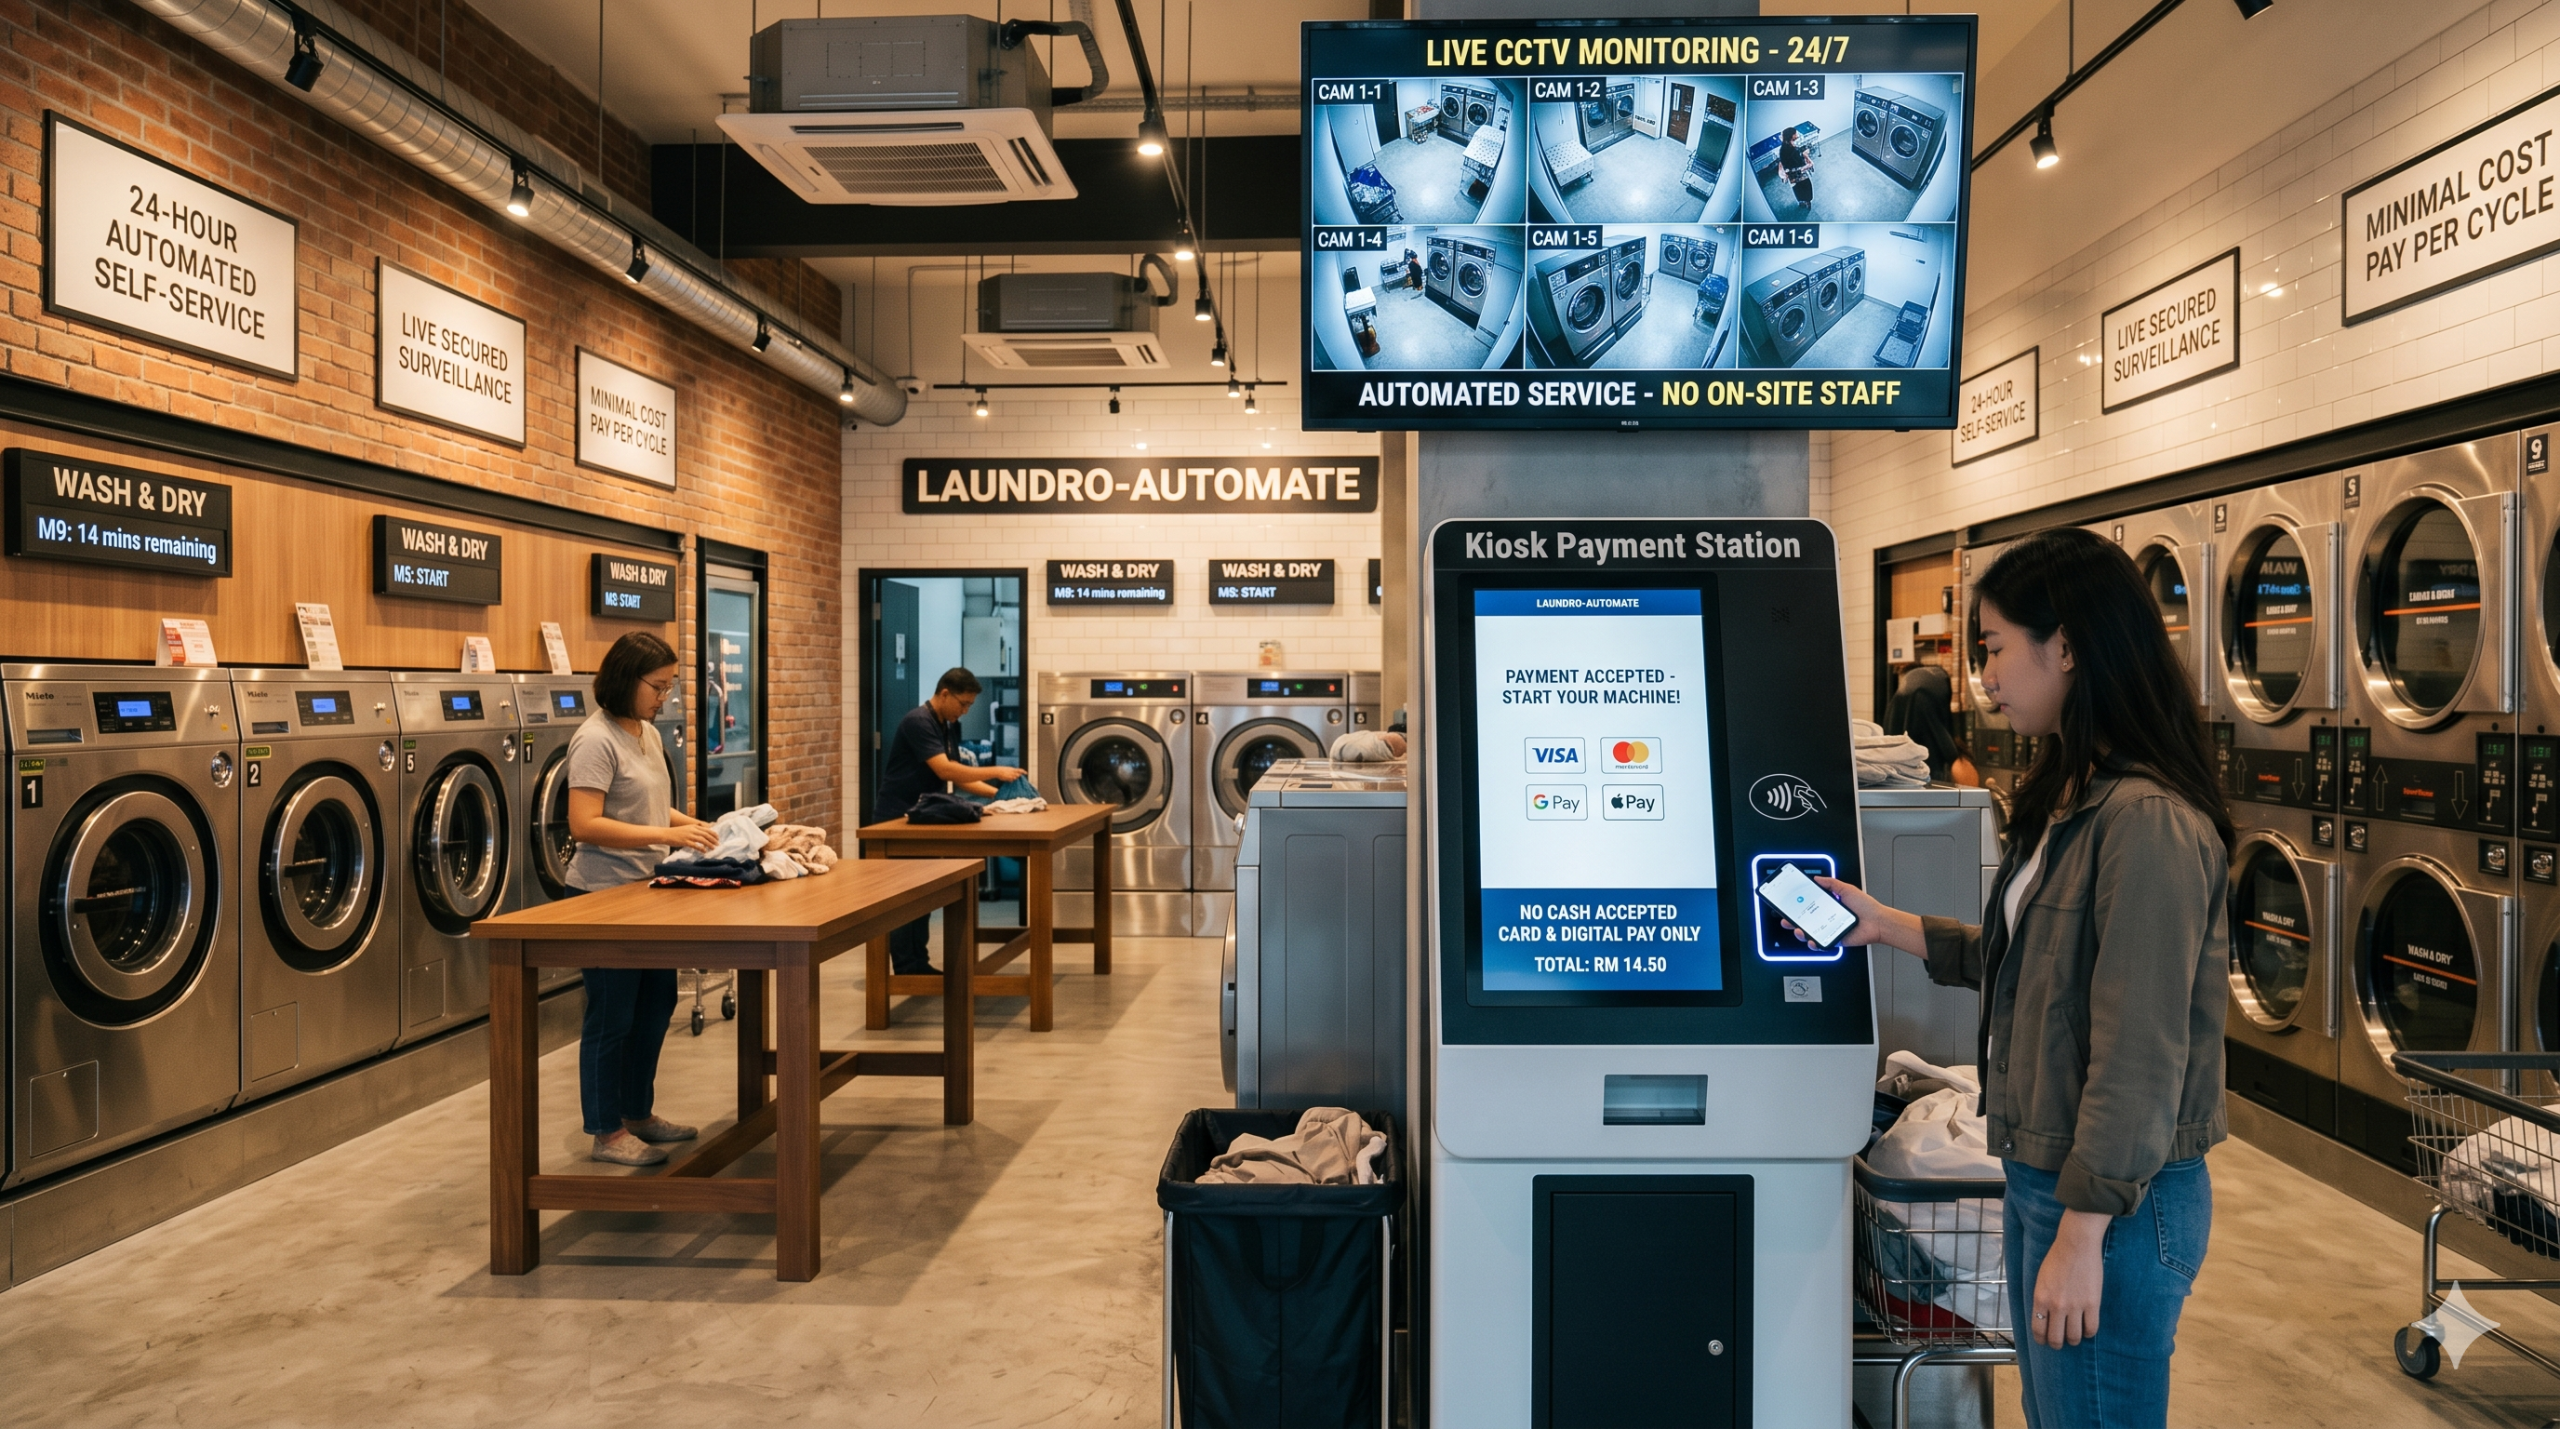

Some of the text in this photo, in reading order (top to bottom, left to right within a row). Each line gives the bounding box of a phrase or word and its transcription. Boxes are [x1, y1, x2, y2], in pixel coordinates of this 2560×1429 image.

[1427, 36, 1850, 66] LIVE CCTV MONITORING - 24/7
[1318, 84, 1382, 100] CAM 1-1
[1535, 82, 1600, 98] CAM 1-2
[1754, 80, 1818, 96] CAM 1-3
[2367, 129, 2552, 242] MINIMAL COST
[130, 185, 237, 253] 24-HOUR
[2367, 175, 2554, 282] PAY PER CYCLE
[1318, 232, 1383, 247] CAM 1-4
[1532, 230, 1597, 246] CAM 1-5
[1748, 229, 1813, 245] CAM 1-6
[106, 219, 257, 297] AUTOMATED
[94, 257, 265, 340] SELF-SERVICE
[2118, 288, 2216, 351] LIVE SECURED
[402, 312, 508, 372] LIVE SECURED
[2114, 318, 2221, 382] SURVEILLANCE
[399, 346, 512, 404] SURVEILLANCE
[1359, 382, 1520, 407] AUTOMATED
[1527, 381, 1636, 407] SERVICE
[1662, 381, 1699, 406] NO
[1707, 380, 1813, 406] ON-SITE
[1819, 380, 1901, 405] STAFF
[1971, 380, 2013, 414] 24-HOUR
[591, 386, 667, 430] MINIMAL COST
[1961, 400, 2026, 443] SELF-SERVICE
[591, 414, 667, 456] PAY PER CYCLE
[2531, 438, 2543, 460] 9
[53, 467, 207, 517] WASH & DRY
[917, 467, 1361, 502] LAUNDRO-AUTOMATE
[38, 517, 217, 565] M9: 14 mins remaining
[401, 527, 488, 561] WASH & DRY
[1465, 531, 1801, 565] Kiosk Payment Station
[416, 567, 449, 587] START
[610, 561, 667, 586] WASH & DRY
[1060, 563, 1160, 578] WASH & DRY
[1222, 563, 1322, 578] WASH & DRY
[1077, 587, 1090, 598] 14
[1091, 587, 1116, 598] mins
[1241, 586, 1277, 598] START
[1536, 599, 1639, 608] LAUNDRO-AUTOMATE
[1505, 669, 1579, 684] PAYMENT
[1584, 669, 1665, 684] ACCEPTED
[1502, 689, 1680, 705] START YOUR MACHINE!
[407, 754, 414, 771] 5
[1532, 747, 1579, 763] VISA
[250, 763, 259, 784] 2
[27, 780, 36, 804] 1
[1553, 795, 1580, 813] Pay
[1626, 795, 1655, 812] Pay
[1520, 904, 1677, 921] NO CASH ACCEPTED
[1498, 926, 1701, 942] CARD & DIGITAL PAY ONLY
[1534, 957, 1667, 973] TOTAL: RM 14.50
